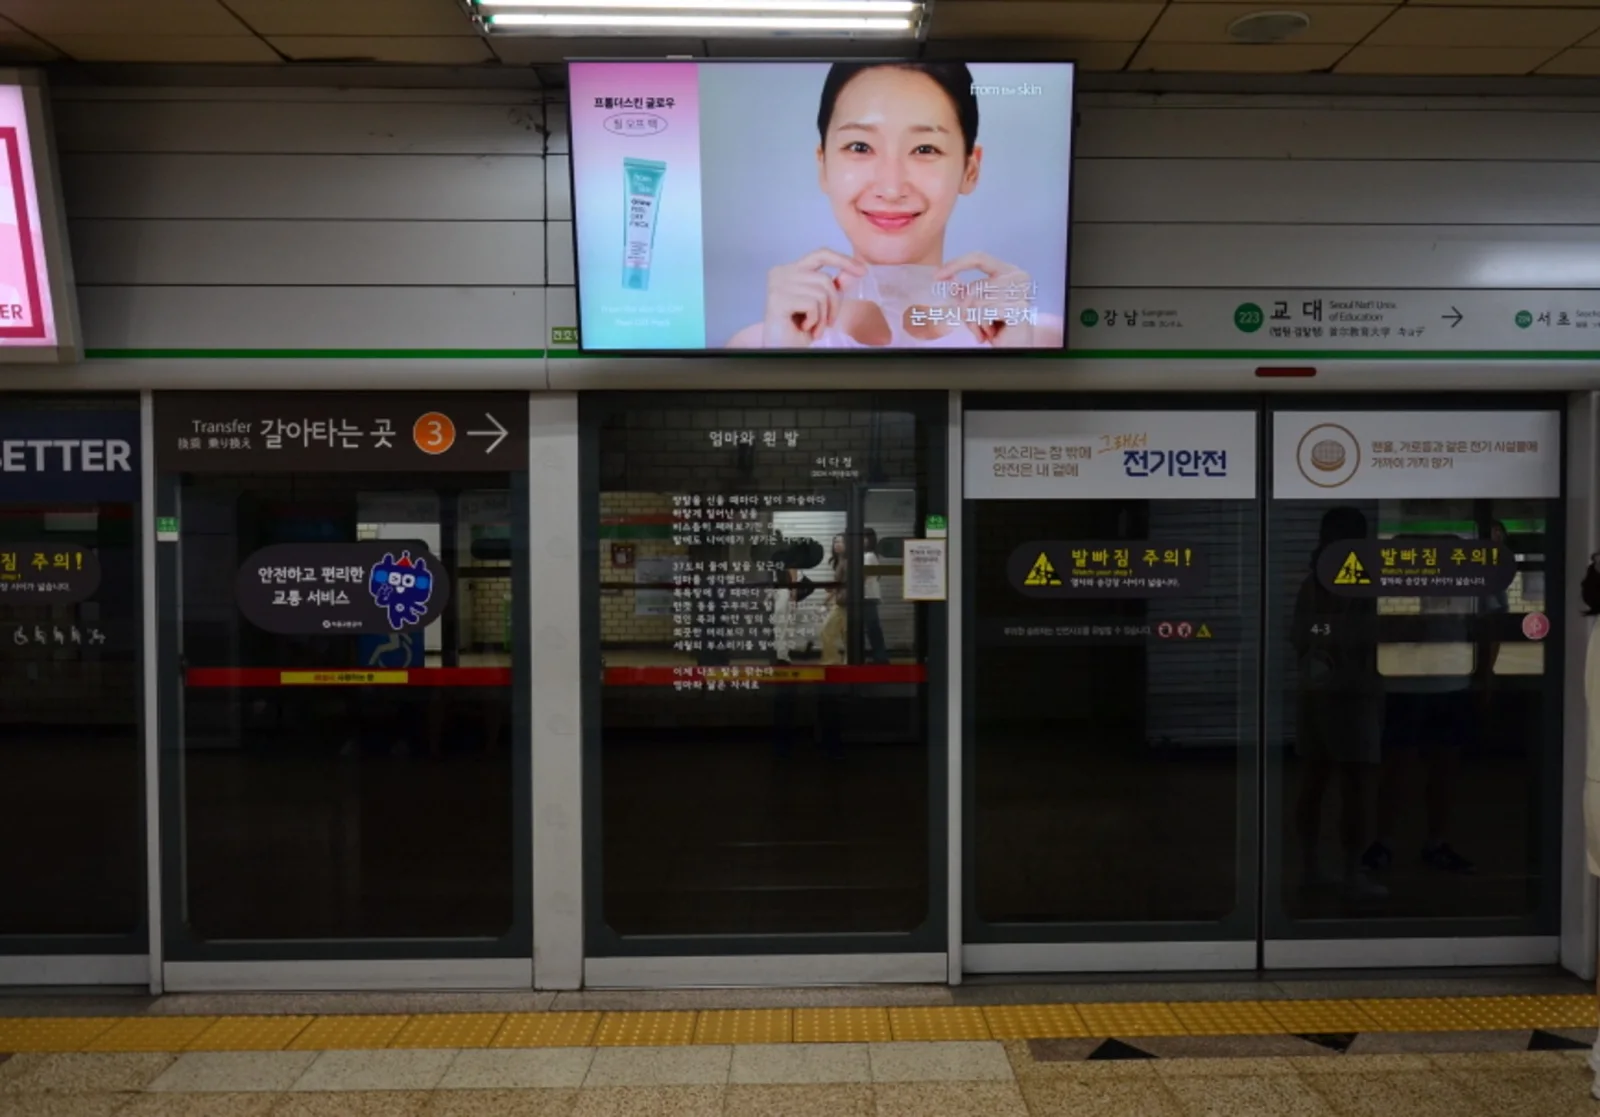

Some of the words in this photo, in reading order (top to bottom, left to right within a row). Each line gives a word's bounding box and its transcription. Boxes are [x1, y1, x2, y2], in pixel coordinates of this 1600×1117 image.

[1017, 82, 1042, 96] skin
[594, 97, 643, 109] 프롬더스킨
[646, 97, 676, 109] 글로우
[1005, 280, 1038, 300] 순간
[1329, 300, 1353, 310] Seoul
[910, 307, 961, 326] 눈부신
[965, 307, 1000, 326] 피부
[1004, 307, 1038, 326] 광채
[1239, 311, 1260, 324] 223
[1329, 312, 1339, 322] of
[1340, 312, 1383, 322] Education
[192, 419, 253, 433] Transfer
[260, 417, 364, 449] 갈아타는
[370, 417, 396, 449] 곳
[426, 420, 443, 446] 3
[709, 429, 755, 447] 엄마와
[784, 429, 800, 447] 발
[1098, 432, 1149, 454] 그래서
[1470, 440, 1492, 454] 전기
[0, 438, 133, 473] ETTER
[1123, 450, 1227, 477] 전기안전
[993, 462, 1034, 478] 안전은
[1036, 462, 1049, 478] 내
[31, 551, 84, 572] 주의!
[1142, 548, 1192, 568] 주의!
[1450, 548, 1499, 567] 주의!
[258, 566, 317, 585] 안전하고
[321, 566, 365, 585] 편리한
[272, 589, 302, 606] 교통
[307, 589, 350, 606] 서비스
[1310, 623, 1332, 636] 4-3
